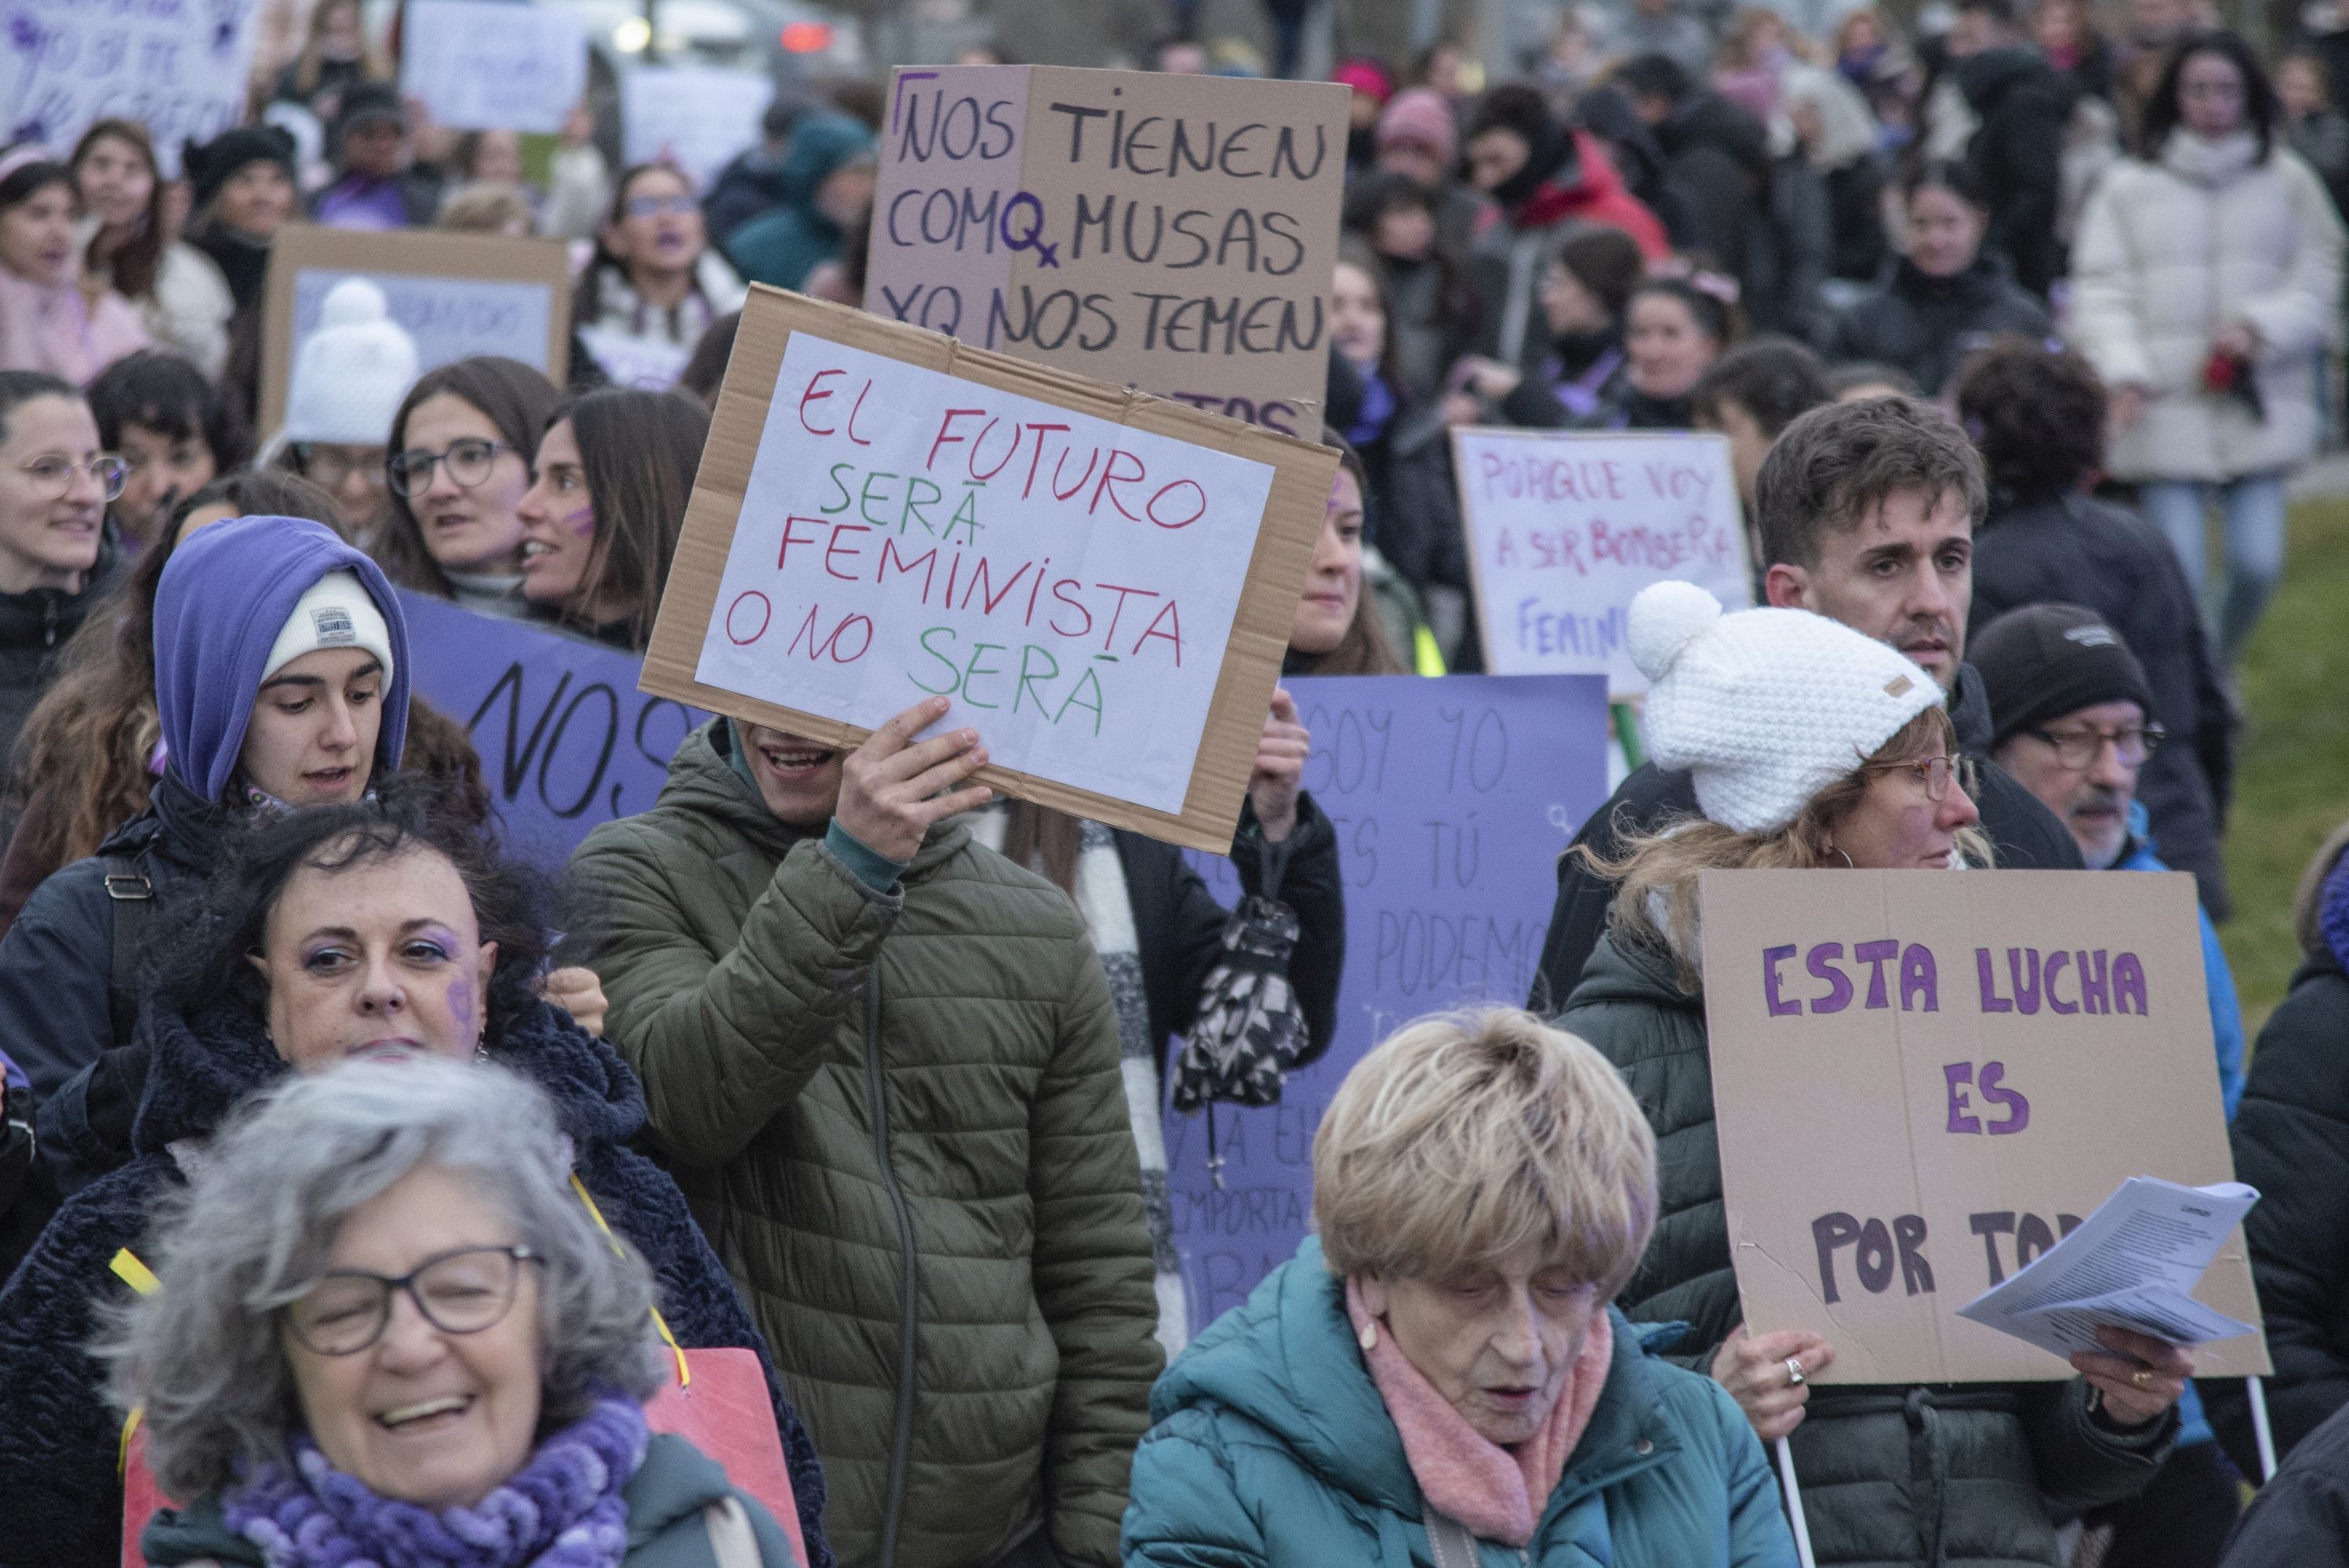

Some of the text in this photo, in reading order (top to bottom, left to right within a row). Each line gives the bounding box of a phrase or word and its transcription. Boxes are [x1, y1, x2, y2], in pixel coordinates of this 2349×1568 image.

[899, 86, 1326, 181] NOS TIENEN
[1071, 192, 1305, 275] MUSAS
[986, 284, 1117, 352] NOS
[1131, 291, 1324, 355] TEMEN
[799, 368, 872, 445] EL
[927, 408, 1207, 530] FUTURO
[1643, 461, 1715, 506] VOY
[1496, 525, 1519, 568] A
[725, 590, 772, 646] O
[786, 603, 873, 663] NO
[777, 514, 1182, 669] FEMINISTA
[1762, 938, 2150, 1018] ESTA LUCHA
[1942, 1061, 2031, 1136] ES
[1810, 1210, 1937, 1305] POR
